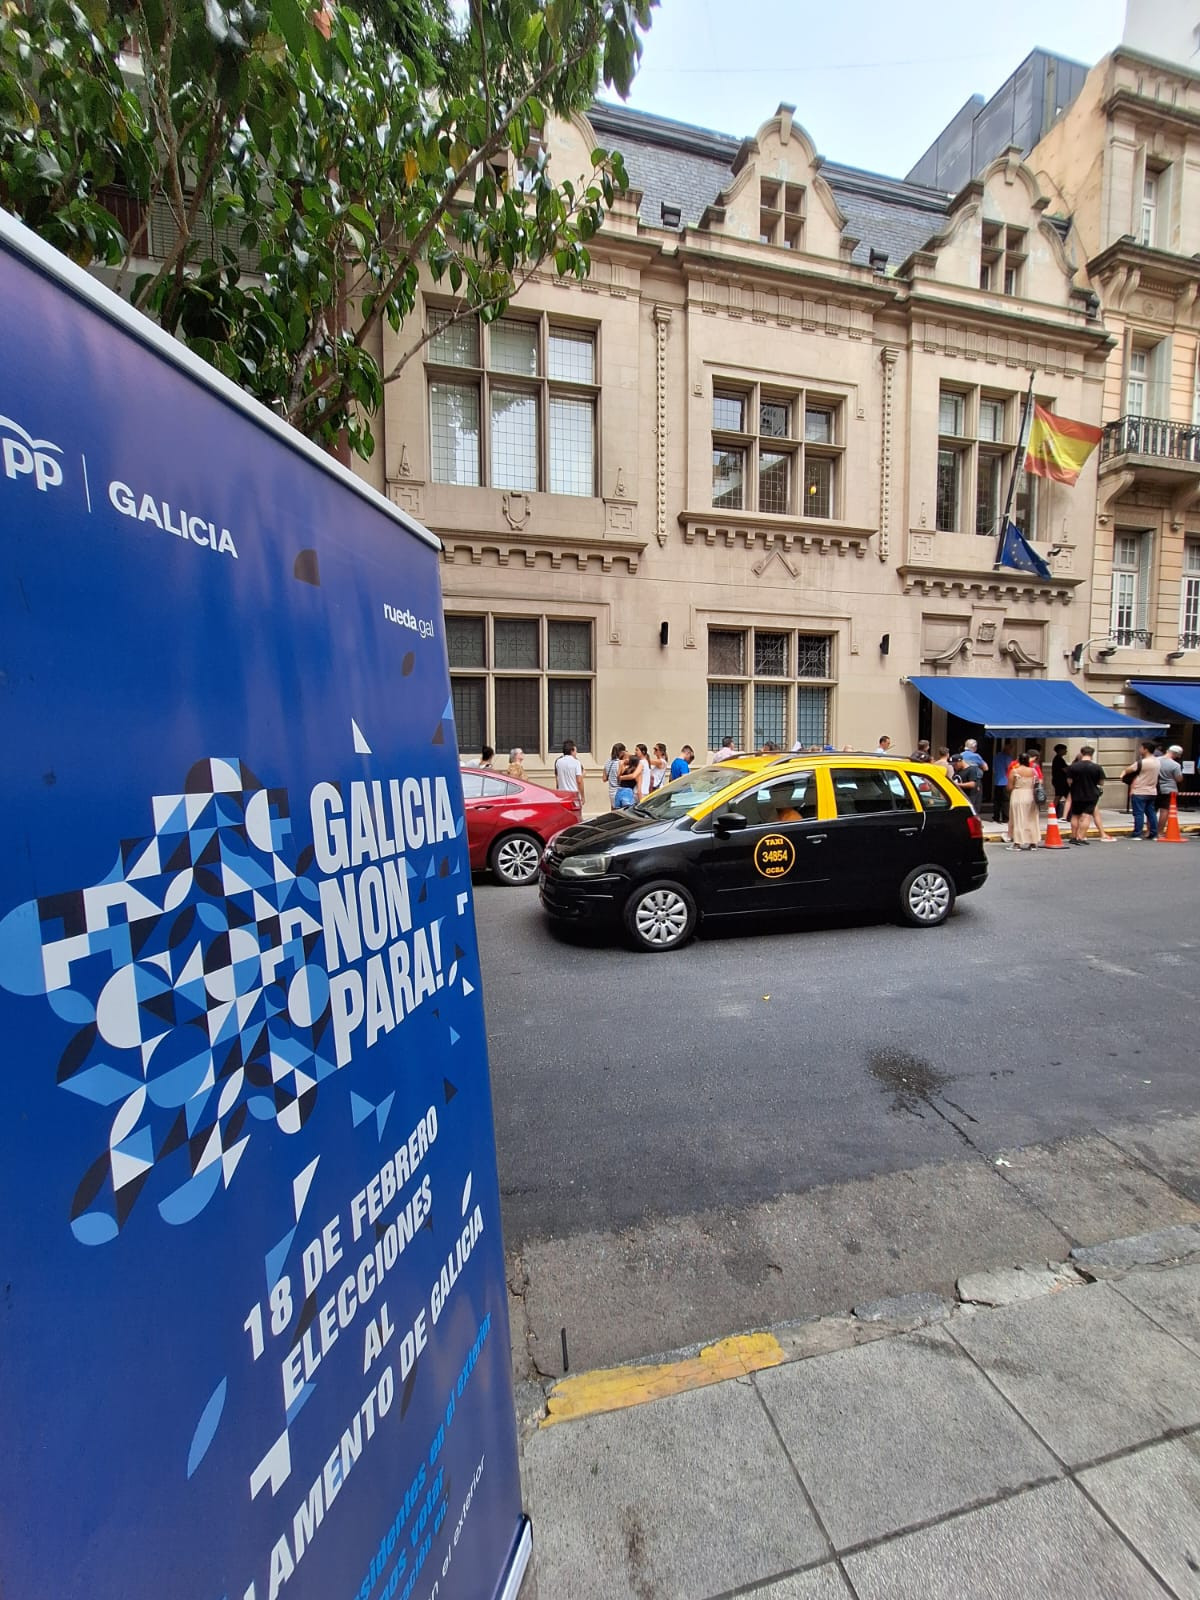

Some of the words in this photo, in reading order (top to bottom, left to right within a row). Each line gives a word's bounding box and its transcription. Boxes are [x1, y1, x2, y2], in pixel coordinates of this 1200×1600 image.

[108, 480, 238, 558] GALICIA
[383, 603, 434, 639] rueda.gal
[310, 776, 457, 875] GALICIA
[318, 857, 412, 972] NON
[329, 919, 444, 1069] PARA!
[244, 1276, 293, 1361] 18
[302, 1214, 343, 1299] DE
[351, 1105, 438, 1242] FEBRERO
[281, 1174, 432, 1411] ELECCIONES
[400, 1307, 428, 1382] DE
[430, 1204, 484, 1325] GALICIA
[363, 1302, 394, 1375] AL
[353, 1461, 426, 1600] sidentes
[429, 1423, 444, 1466] en
[446, 1387, 456, 1427] el
[457, 1311, 491, 1398] exterior
[411, 1465, 444, 1547] votar
[427, 1580, 439, 1600] n
[442, 1543, 451, 1577] el
[454, 1454, 485, 1546] exterior
